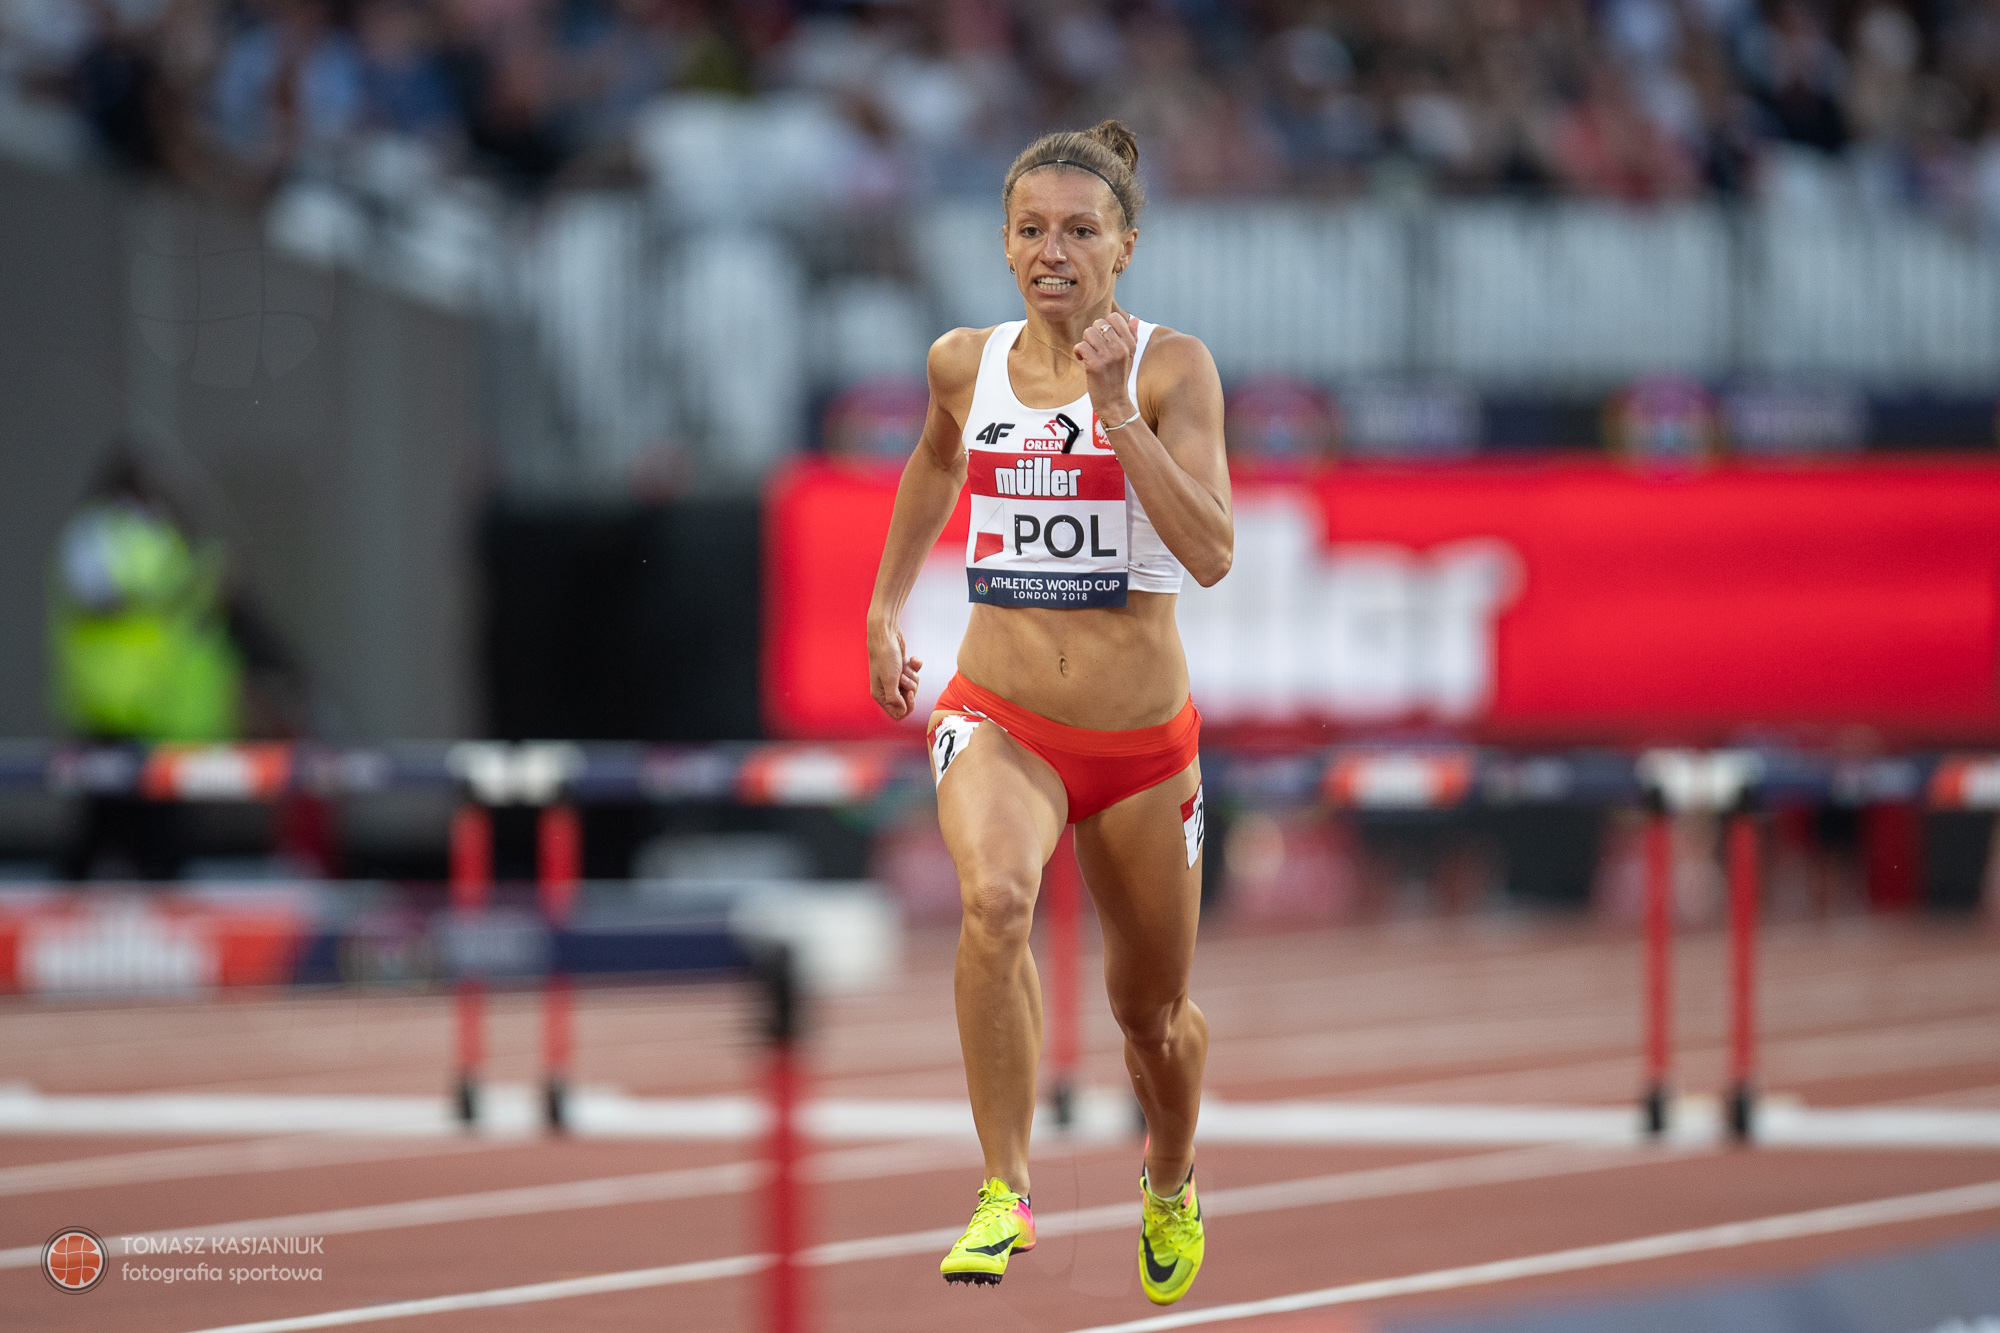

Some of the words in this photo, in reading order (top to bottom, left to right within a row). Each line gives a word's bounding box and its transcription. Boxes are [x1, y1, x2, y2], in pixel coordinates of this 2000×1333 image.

[976, 422, 1016, 445] 4F
[1025, 440, 1064, 451] ORLEN
[994, 456, 1082, 497] müller
[1014, 514, 1117, 559] POL
[991, 577, 1043, 590] ATHLETICS
[1046, 579, 1093, 592] WORLD
[1095, 580, 1120, 592] CUP
[1013, 590, 1056, 600] LONDON
[1062, 592, 1088, 601] 2018
